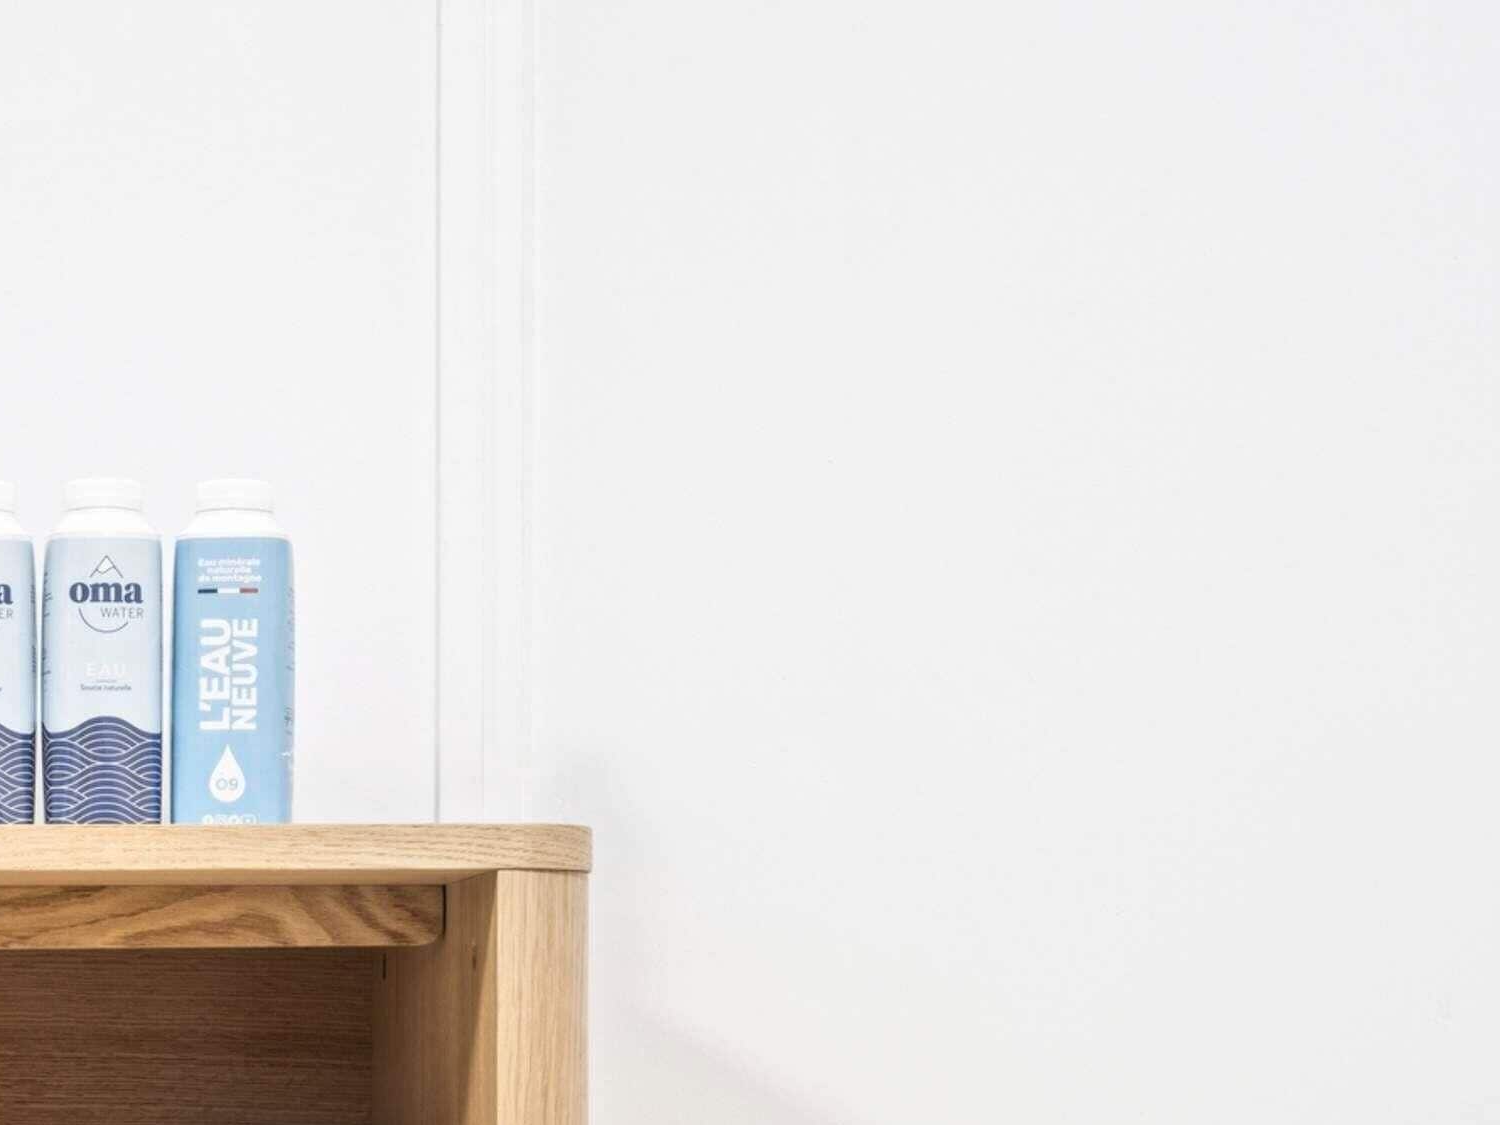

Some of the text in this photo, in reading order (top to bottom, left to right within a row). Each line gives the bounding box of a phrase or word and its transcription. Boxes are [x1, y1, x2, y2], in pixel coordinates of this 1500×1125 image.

[69, 582, 143, 604] oma
[100, 607, 144, 619] WATER
[86, 663, 125, 679] EAU
[199, 618, 231, 730] L'EAU
[231, 618, 258, 730] NEUVE
